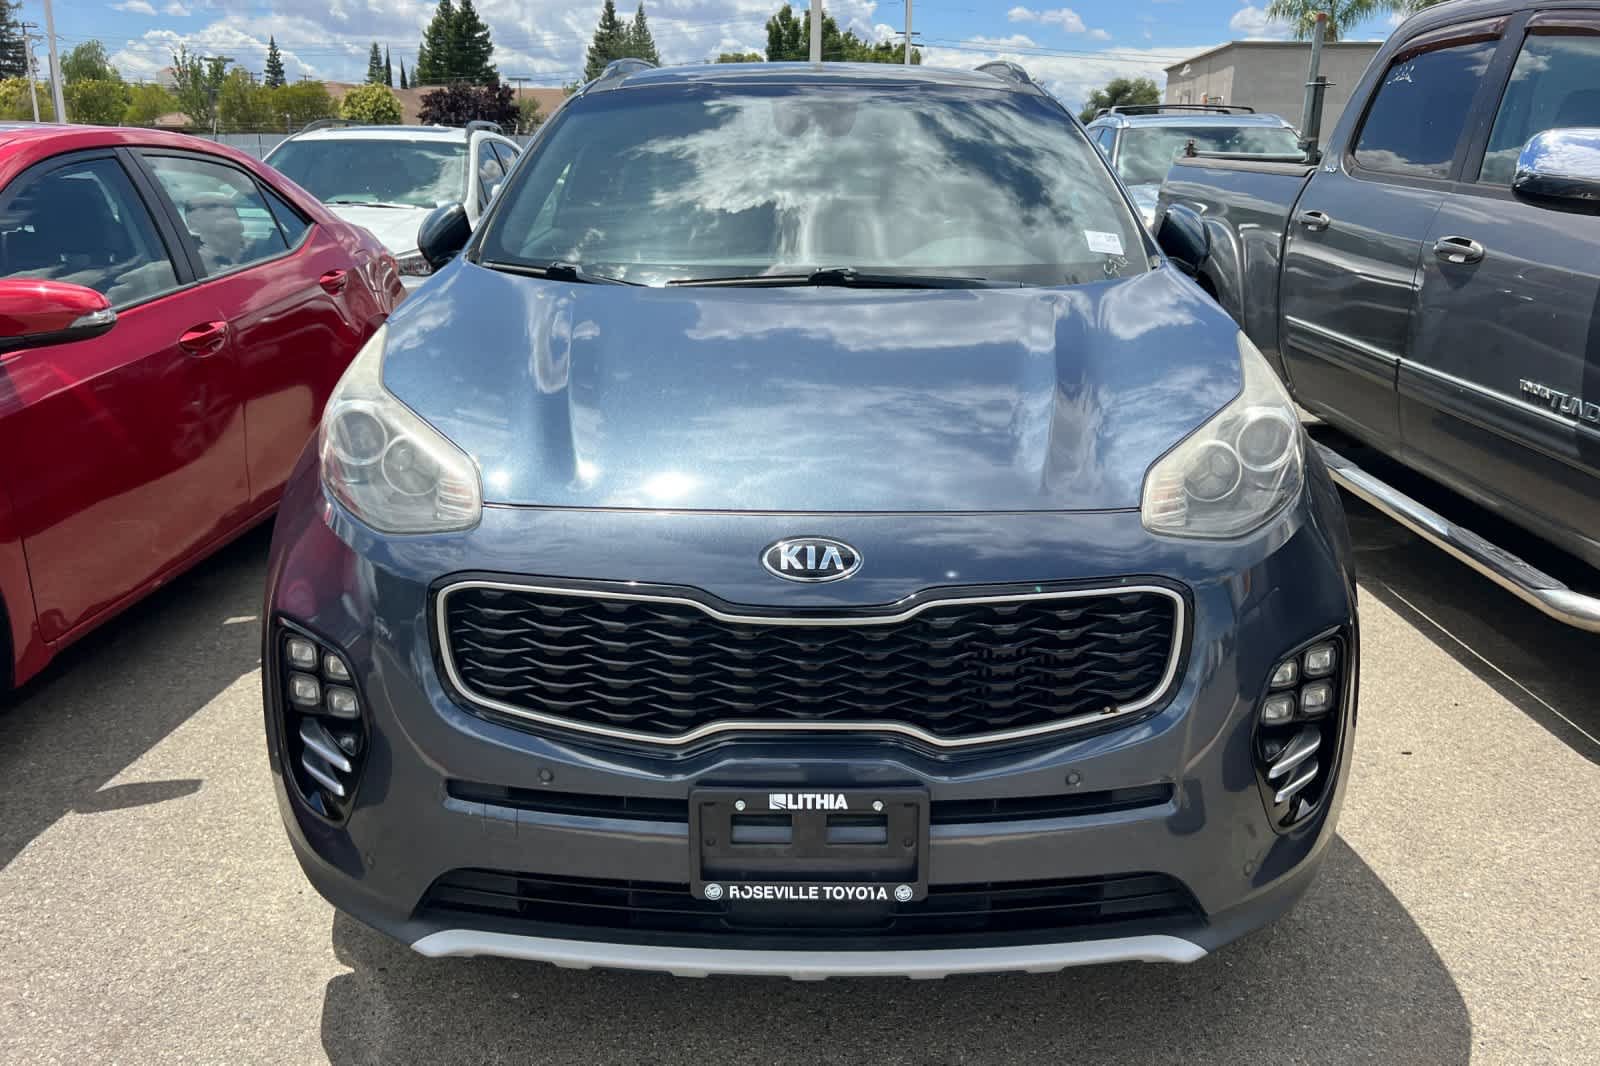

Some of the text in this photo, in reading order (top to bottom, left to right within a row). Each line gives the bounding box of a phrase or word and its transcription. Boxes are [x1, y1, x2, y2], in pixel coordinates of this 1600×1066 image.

[780, 545, 844, 570] KIA
[787, 793, 848, 810] LITHIA
[729, 885, 888, 900] ROSEVILLE TOYOTA
